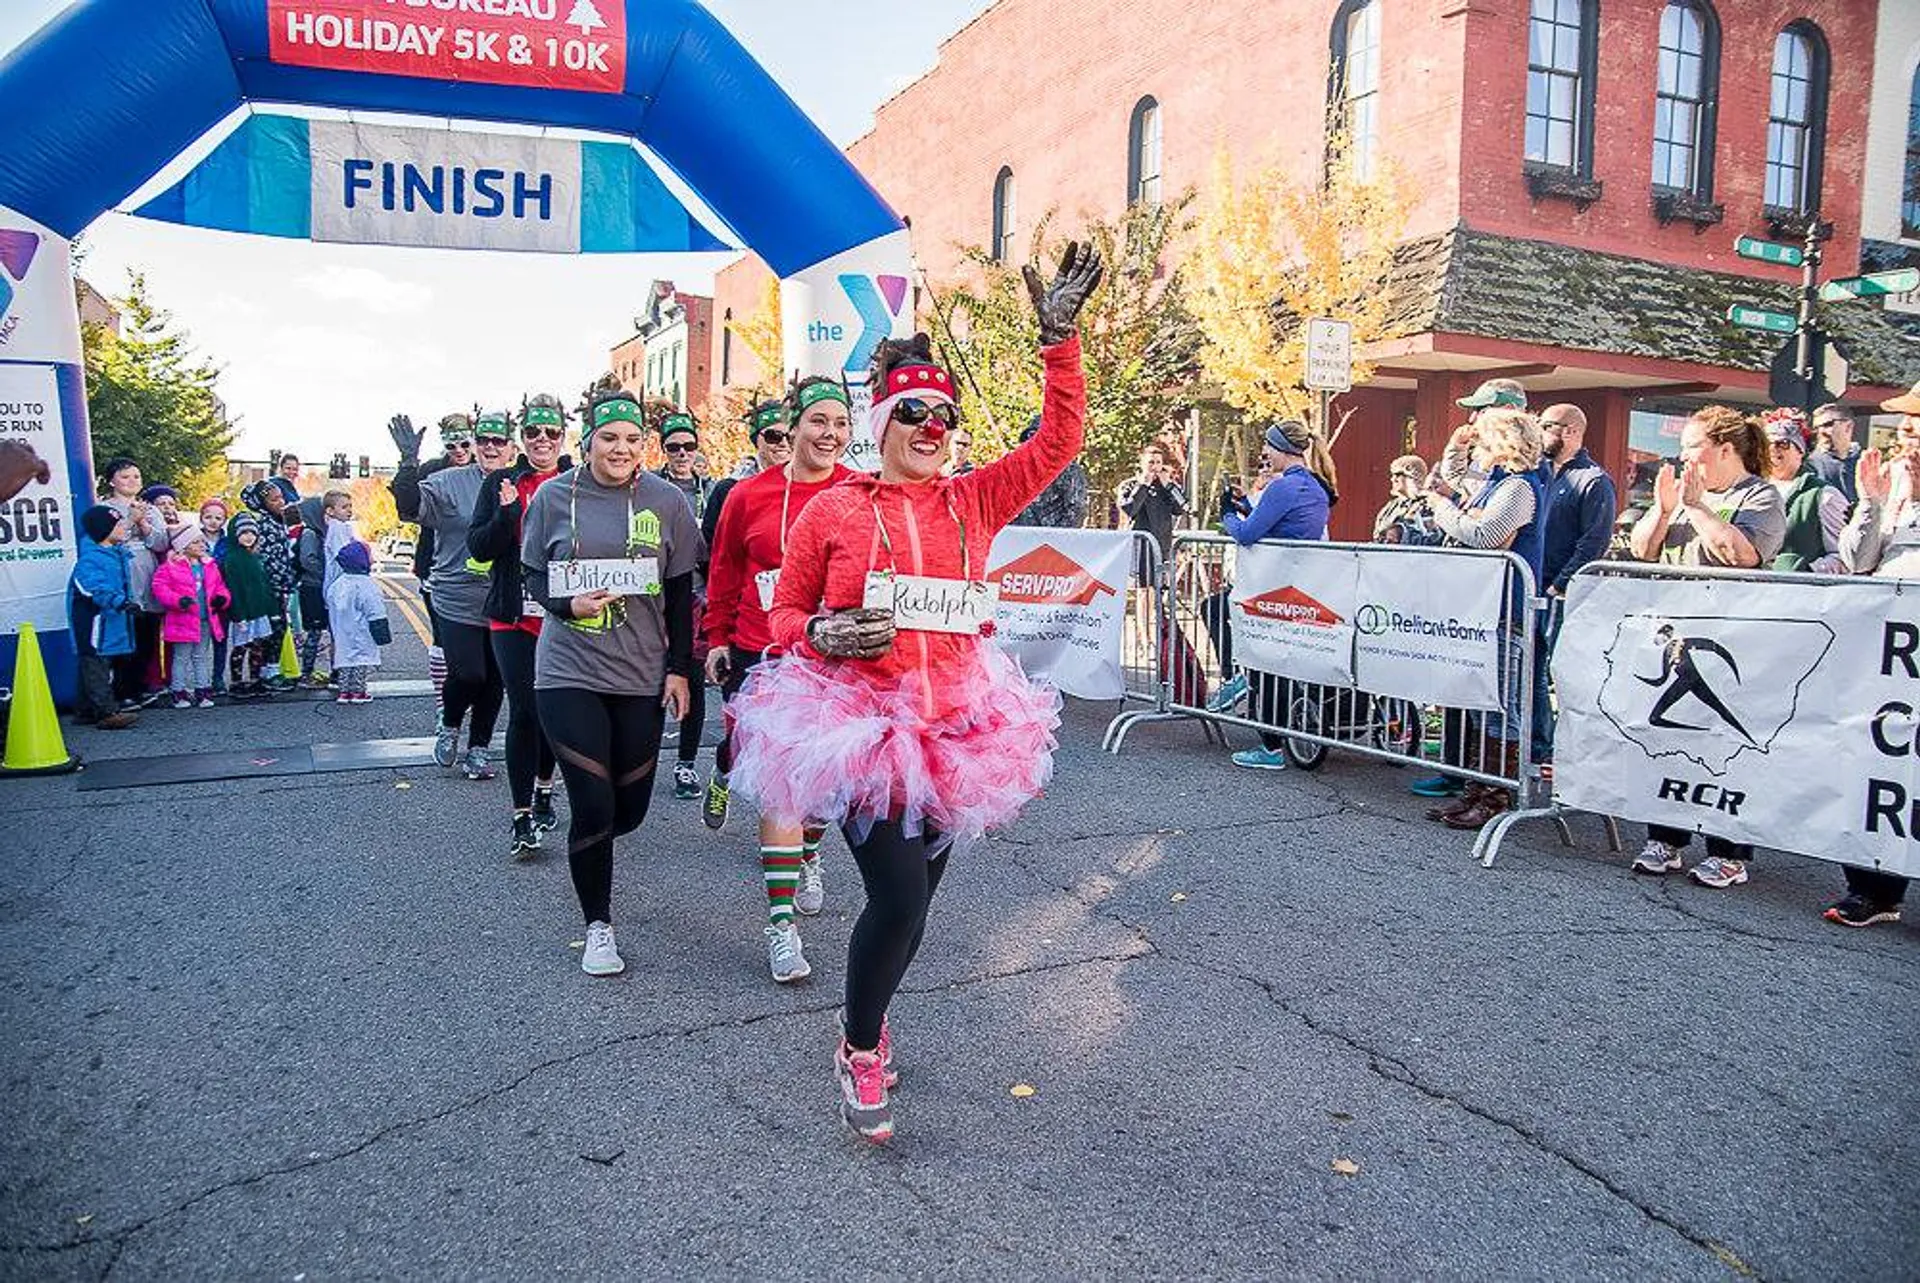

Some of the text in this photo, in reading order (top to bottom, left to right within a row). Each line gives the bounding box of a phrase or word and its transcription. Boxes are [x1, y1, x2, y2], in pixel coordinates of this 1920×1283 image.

[287, 12, 610, 73] HOLIDAY 5K & 10K
[344, 159, 552, 220] FINISH
[808, 321, 843, 342] the
[1327, 325, 1334, 337] 2
[25, 404, 43, 416] TO
[12, 421, 43, 432] RUN
[557, 564, 640, 591] Blitzen
[1001, 573, 1075, 597] SERVPRO
[892, 582, 977, 624] Rudolph
[1256, 601, 1319, 620] SERVPRO
[1870, 701, 1920, 757] C
[1657, 777, 1747, 816] RCR
